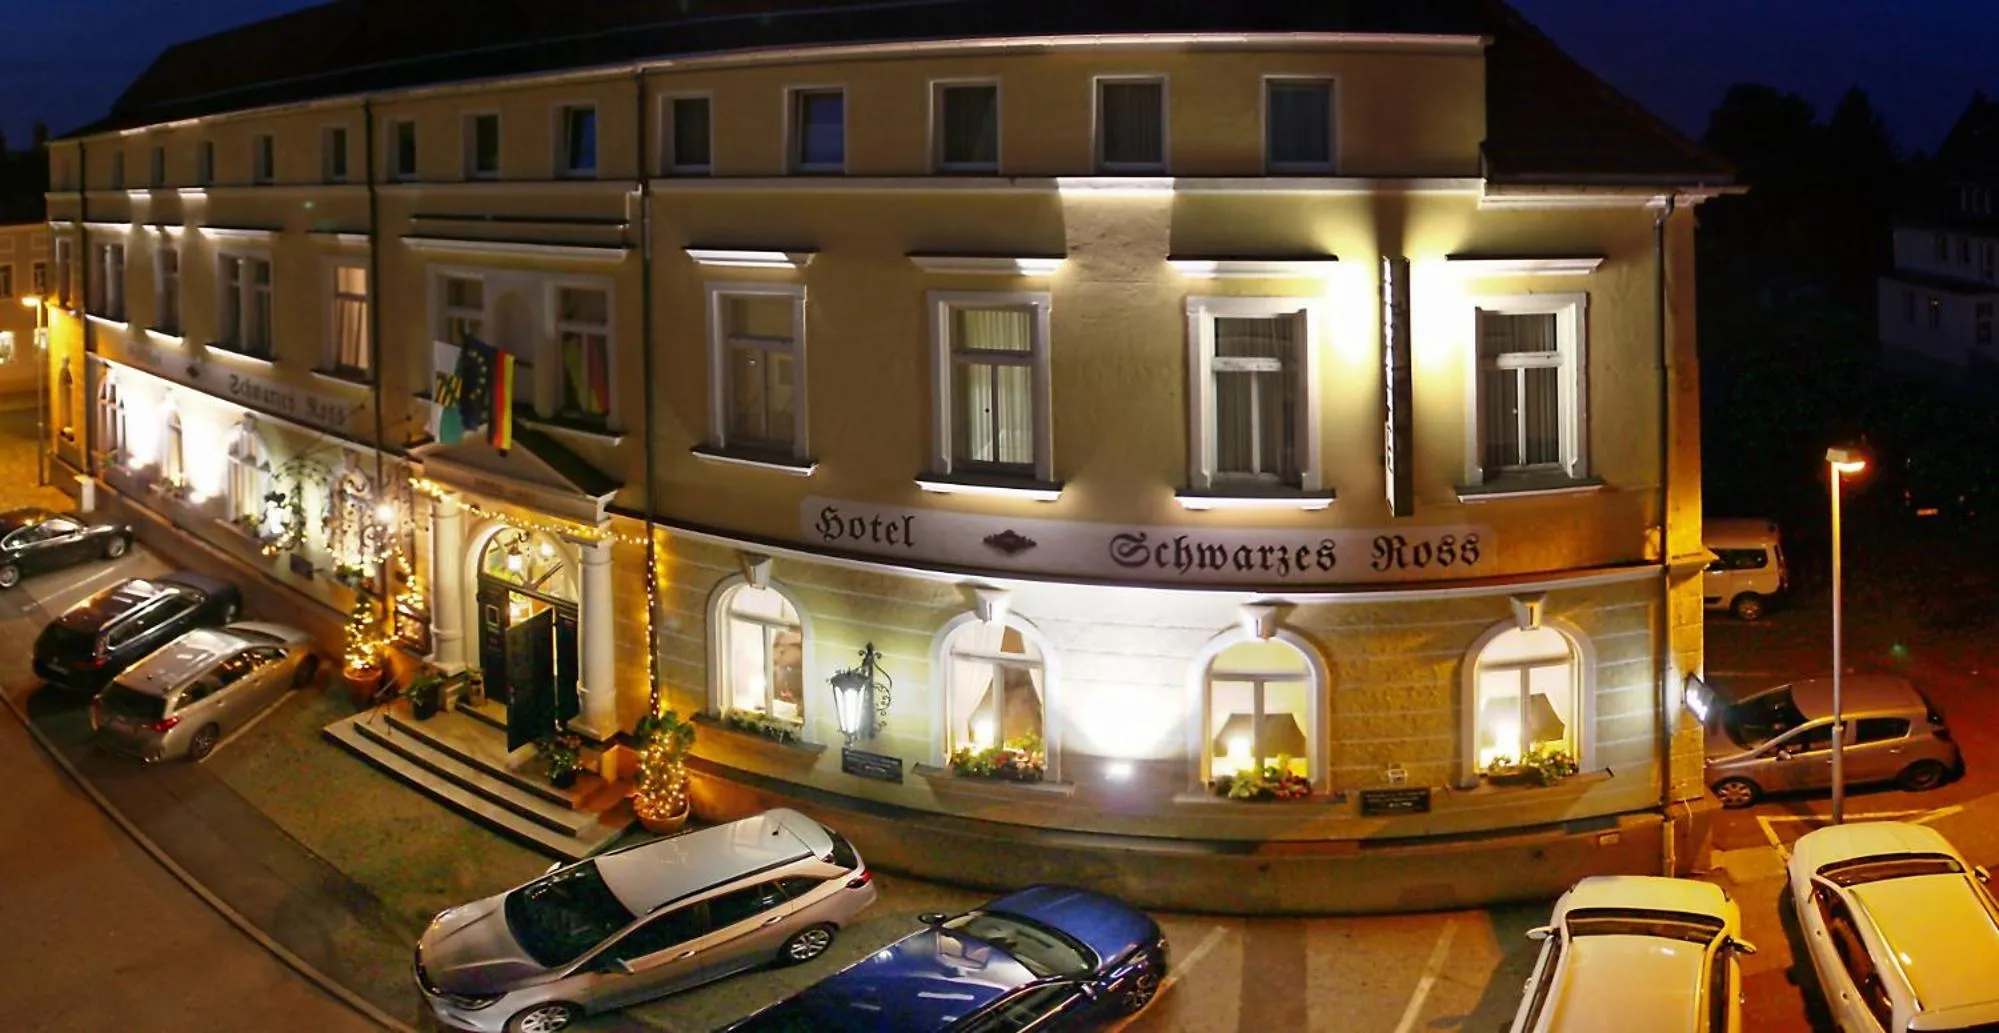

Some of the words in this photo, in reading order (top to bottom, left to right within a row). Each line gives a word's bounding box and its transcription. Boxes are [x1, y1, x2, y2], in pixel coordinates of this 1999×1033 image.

[815, 506, 916, 548] Hotel
[1109, 531, 1337, 576] Schwarzes
[1371, 532, 1482, 571] Ross
